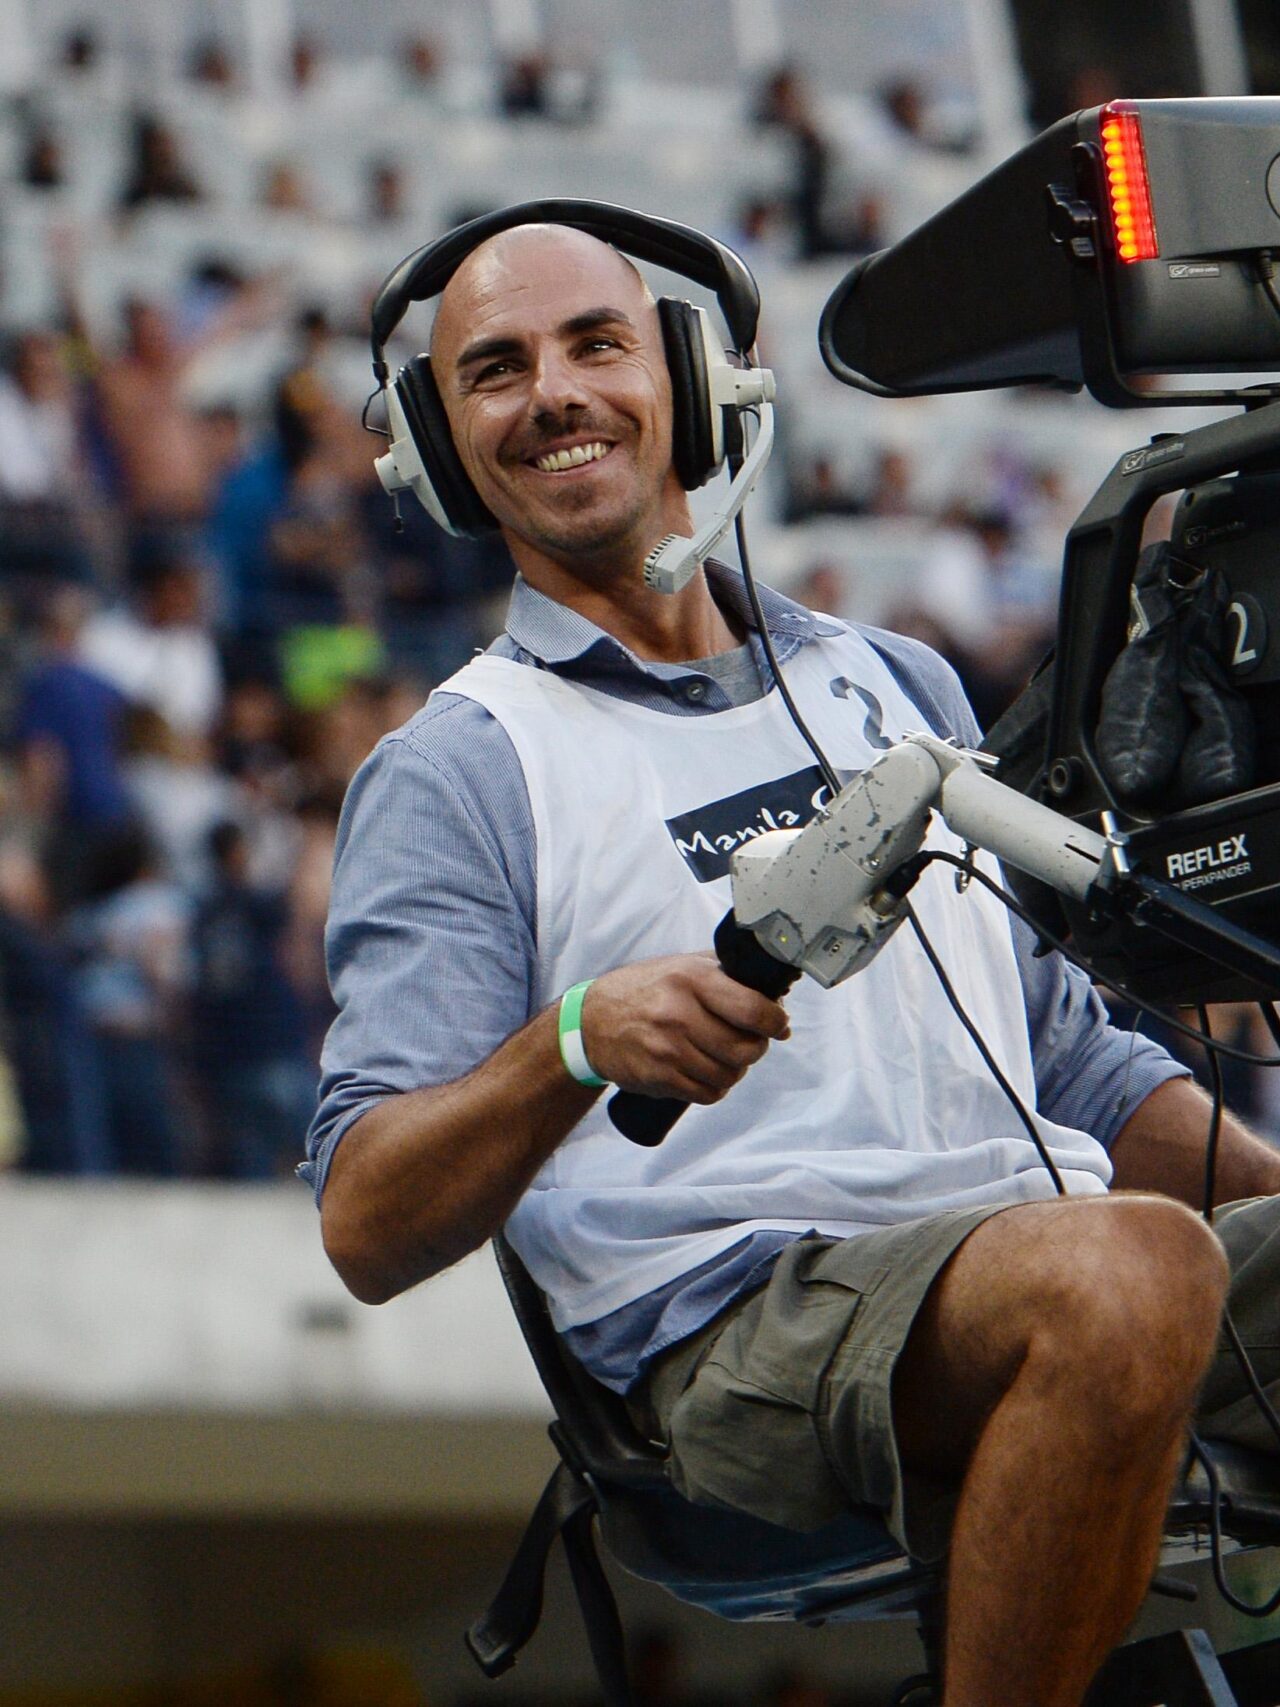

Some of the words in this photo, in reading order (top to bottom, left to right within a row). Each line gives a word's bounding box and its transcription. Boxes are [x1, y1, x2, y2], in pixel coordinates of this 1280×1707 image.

[1228, 602, 1256, 666] 2
[675, 807, 800, 858] Manila
[1167, 833, 1249, 879] REFLEX
